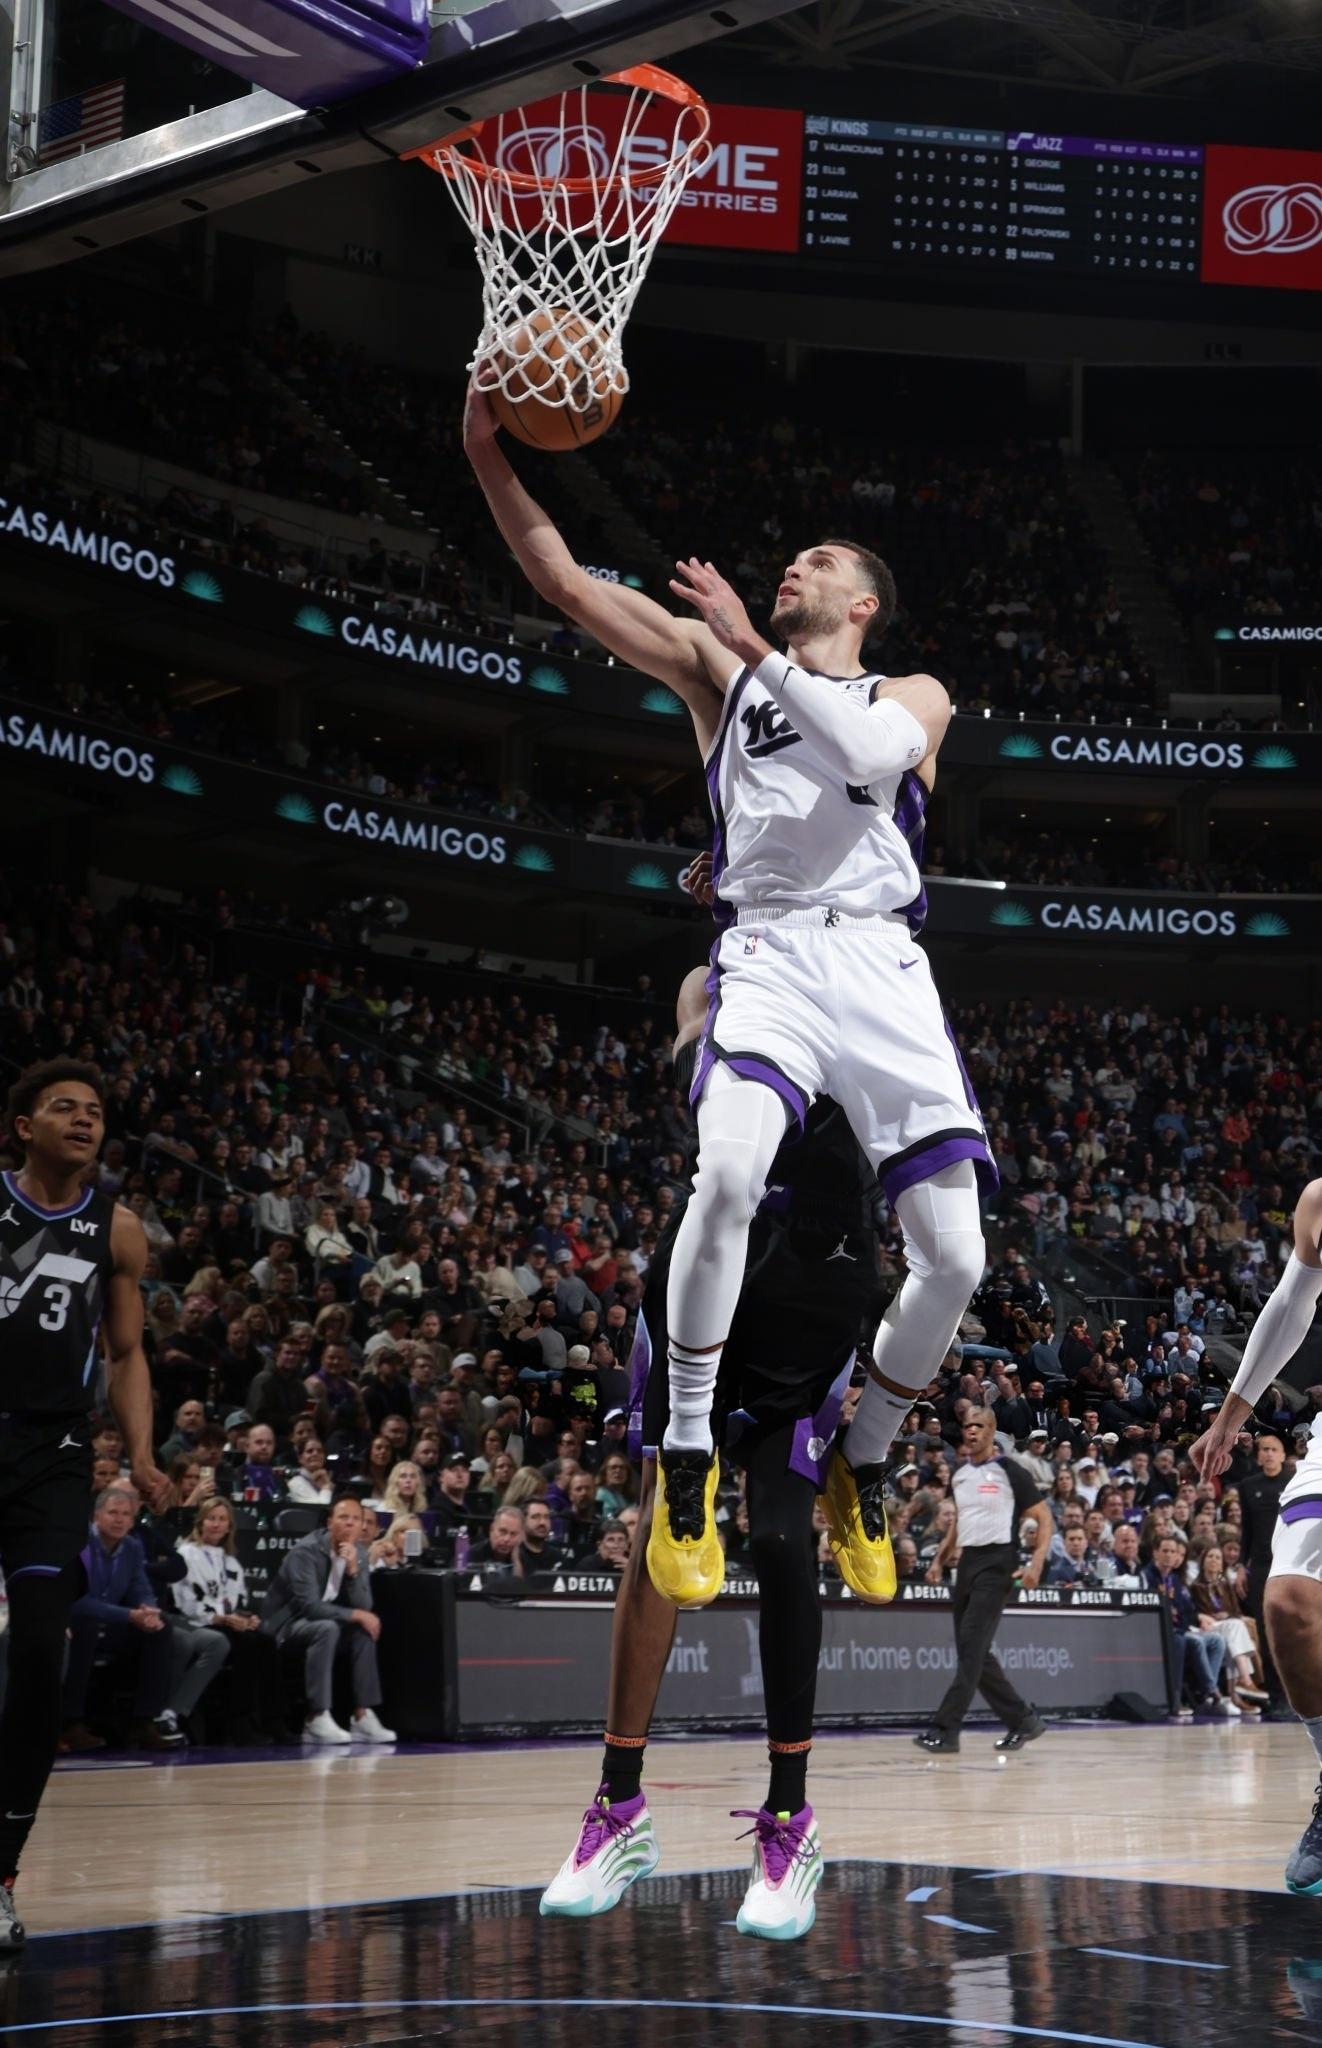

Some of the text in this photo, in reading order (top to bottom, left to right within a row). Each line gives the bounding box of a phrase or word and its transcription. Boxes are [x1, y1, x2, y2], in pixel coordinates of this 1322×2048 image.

[831, 120, 869, 136] KINGS
[1032, 137, 1063, 152] JAZZ
[621, 136, 779, 191] SME
[822, 166, 846, 175] ELLIS
[1025, 159, 1060, 169] GEORGE
[1024, 182, 1065, 192] WILLIAMS
[822, 190, 858, 199] LARAVIA
[821, 213, 847, 221] MONK
[1023, 205, 1065, 215] SPRINGER
[1022, 227, 1069, 238] FILIPOWSKI
[820, 236, 850, 245] LAVINE
[1021, 251, 1054, 260] MARTIN
[341, 616, 522, 685] CASAMIGOS
[0, 716, 155, 783] SAMIGOS
[1051, 735, 1244, 769] CASAMIGOS
[323, 802, 507, 864] CASAMIGOS
[1041, 903, 1236, 937] CASAMIGOS
[70, 1218, 98, 1236] LVT
[39, 1283, 71, 1331] 3
[568, 1577, 614, 1592] DELTA
[719, 1580, 760, 1595] DELTA
[914, 1586, 950, 1599] DELTA
[1028, 1590, 1060, 1602] DELTA
[1081, 1592, 1112, 1604] DELTA
[1130, 1593, 1160, 1605] DELTA
[851, 1640, 911, 1671] home
